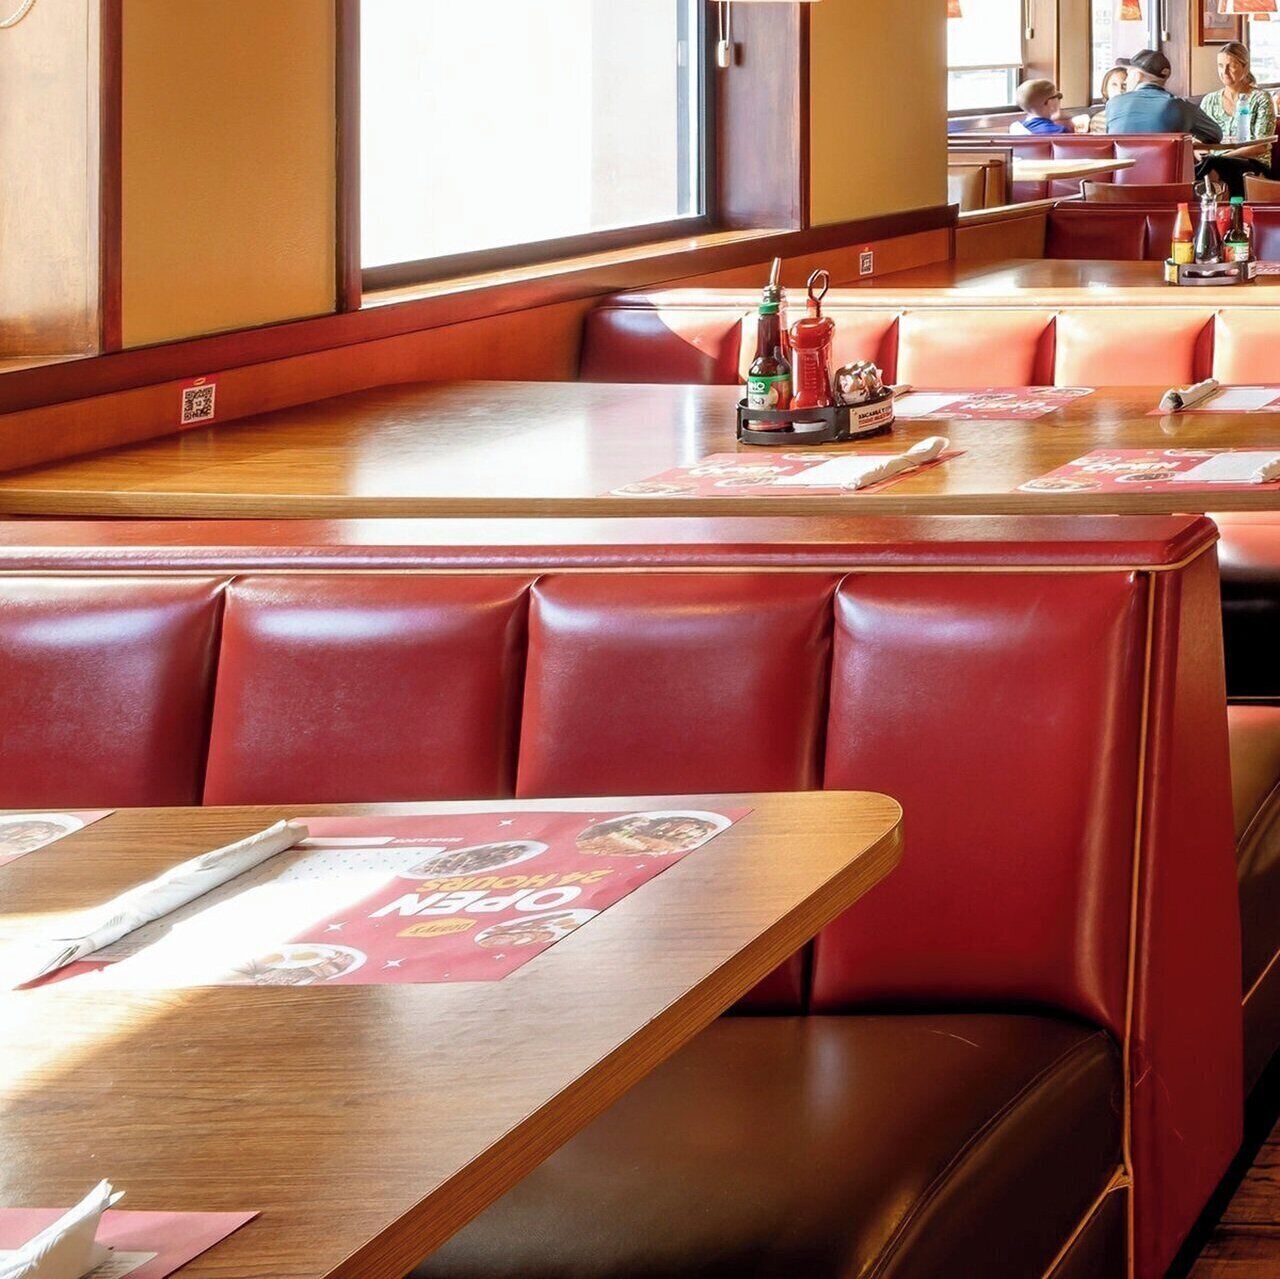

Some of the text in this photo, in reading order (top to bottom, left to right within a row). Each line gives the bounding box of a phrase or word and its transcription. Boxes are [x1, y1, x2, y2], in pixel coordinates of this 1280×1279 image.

[416, 869, 614, 892] 24 HOURS
[368, 886, 581, 917] OPEN
